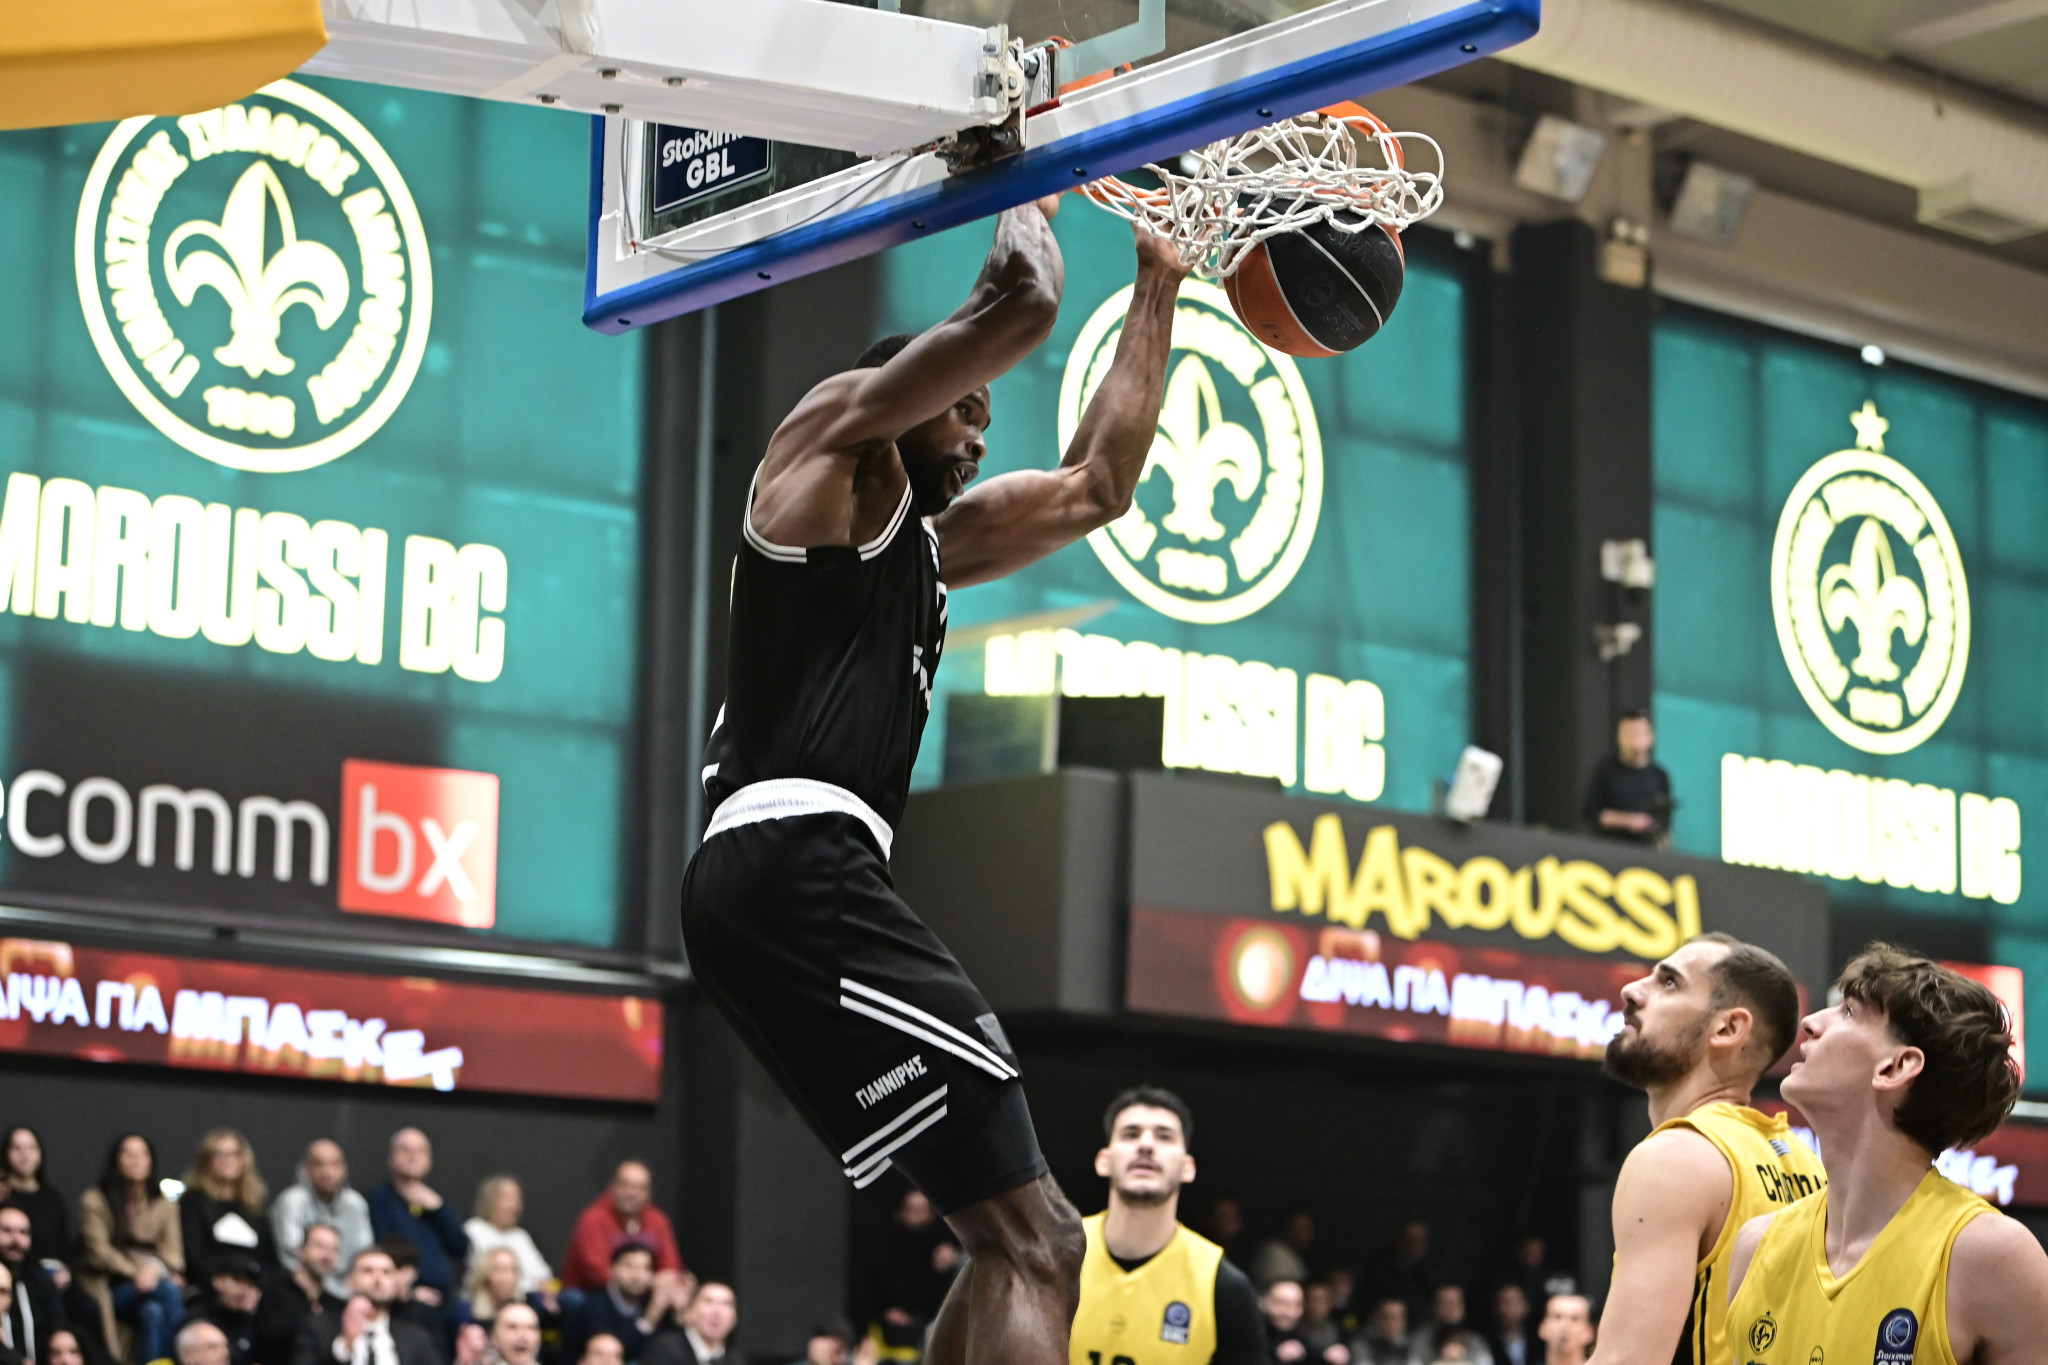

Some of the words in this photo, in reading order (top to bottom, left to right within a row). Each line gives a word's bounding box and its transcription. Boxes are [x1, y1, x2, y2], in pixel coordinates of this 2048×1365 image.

[663, 130, 744, 168] Stoixim
[686, 147, 736, 189] GBL
[0, 471, 388, 666] MAROUSSI
[400, 534, 508, 684] BC
[1304, 672, 1386, 801] BC
[0, 769, 330, 886] comm
[1959, 792, 2021, 905] BC
[1263, 812, 1702, 959] MAROUSSI
[0, 972, 90, 1027] ΙΨΑ
[95, 979, 169, 1034] ΓΙΑ
